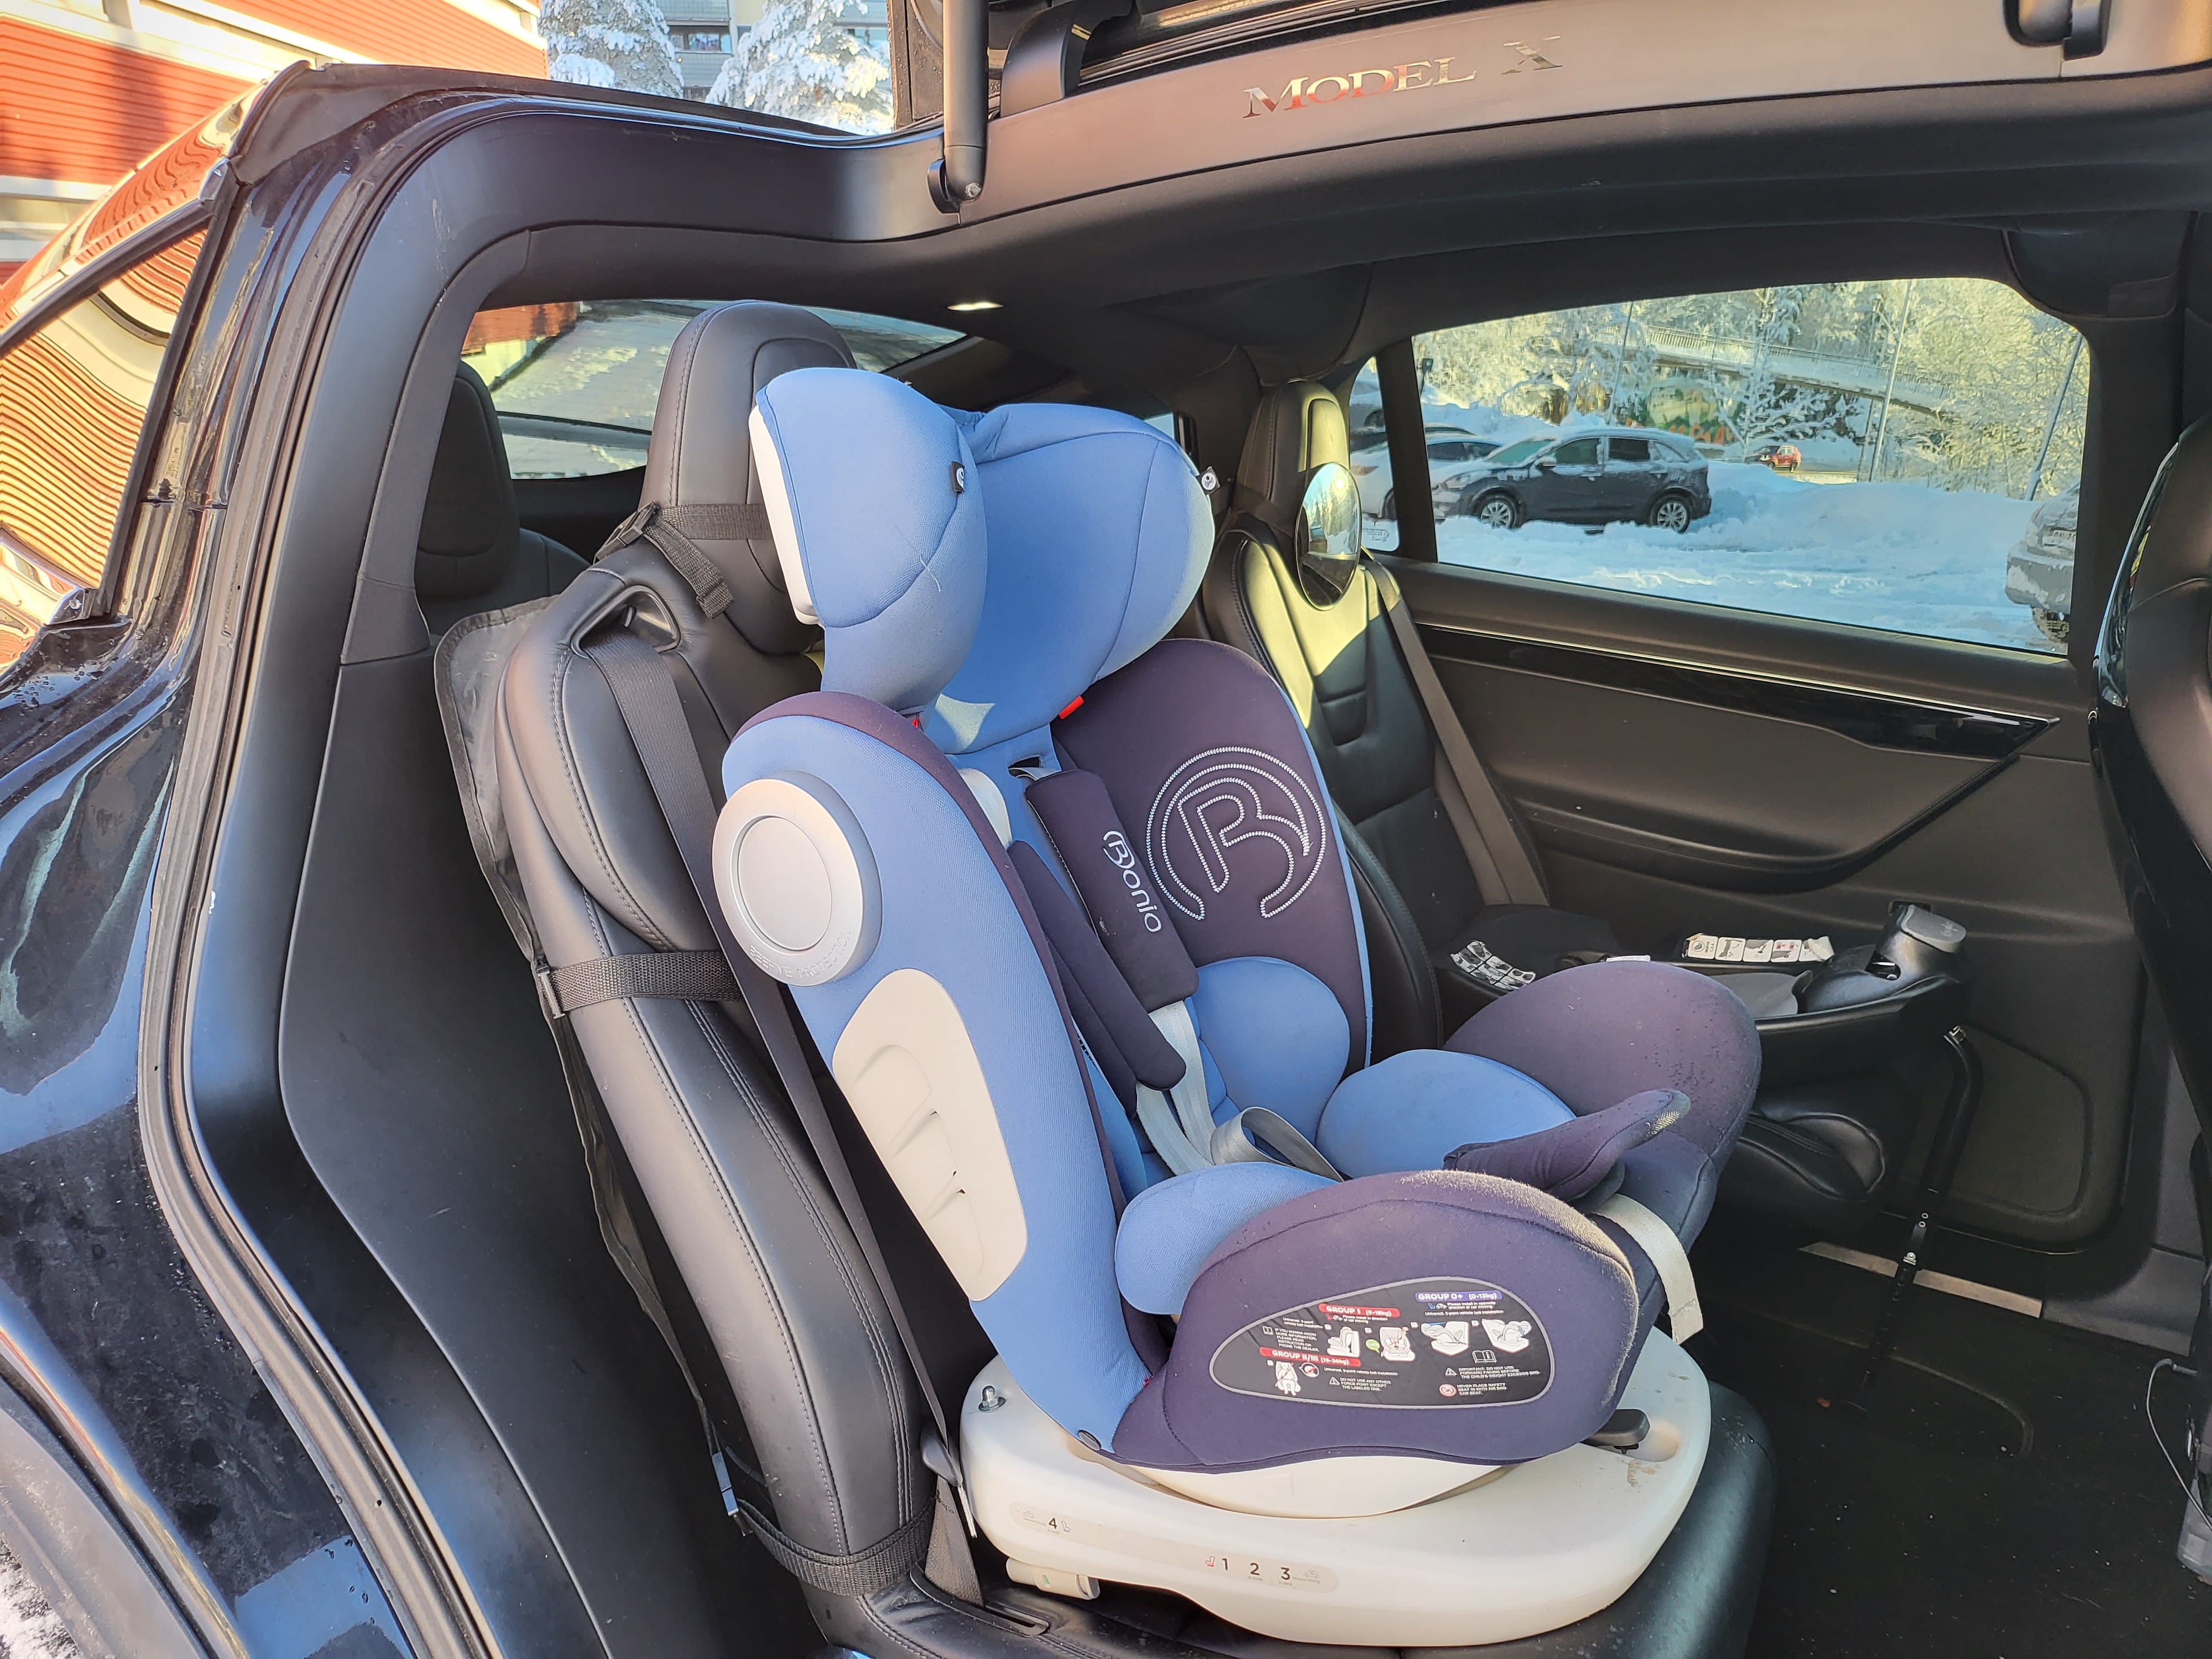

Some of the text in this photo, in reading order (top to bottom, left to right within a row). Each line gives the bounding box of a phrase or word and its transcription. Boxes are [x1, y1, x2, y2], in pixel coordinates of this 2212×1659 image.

[1243, 35, 1563, 119] MODEL X
[796, 928, 852, 978] PROTECTION
[1326, 1306, 1355, 1314] GROUP
[1272, 1350, 1301, 1359] GROUP
[1048, 1517, 1058, 1530] 4
[1222, 1558, 1291, 1580] 1 2 3
